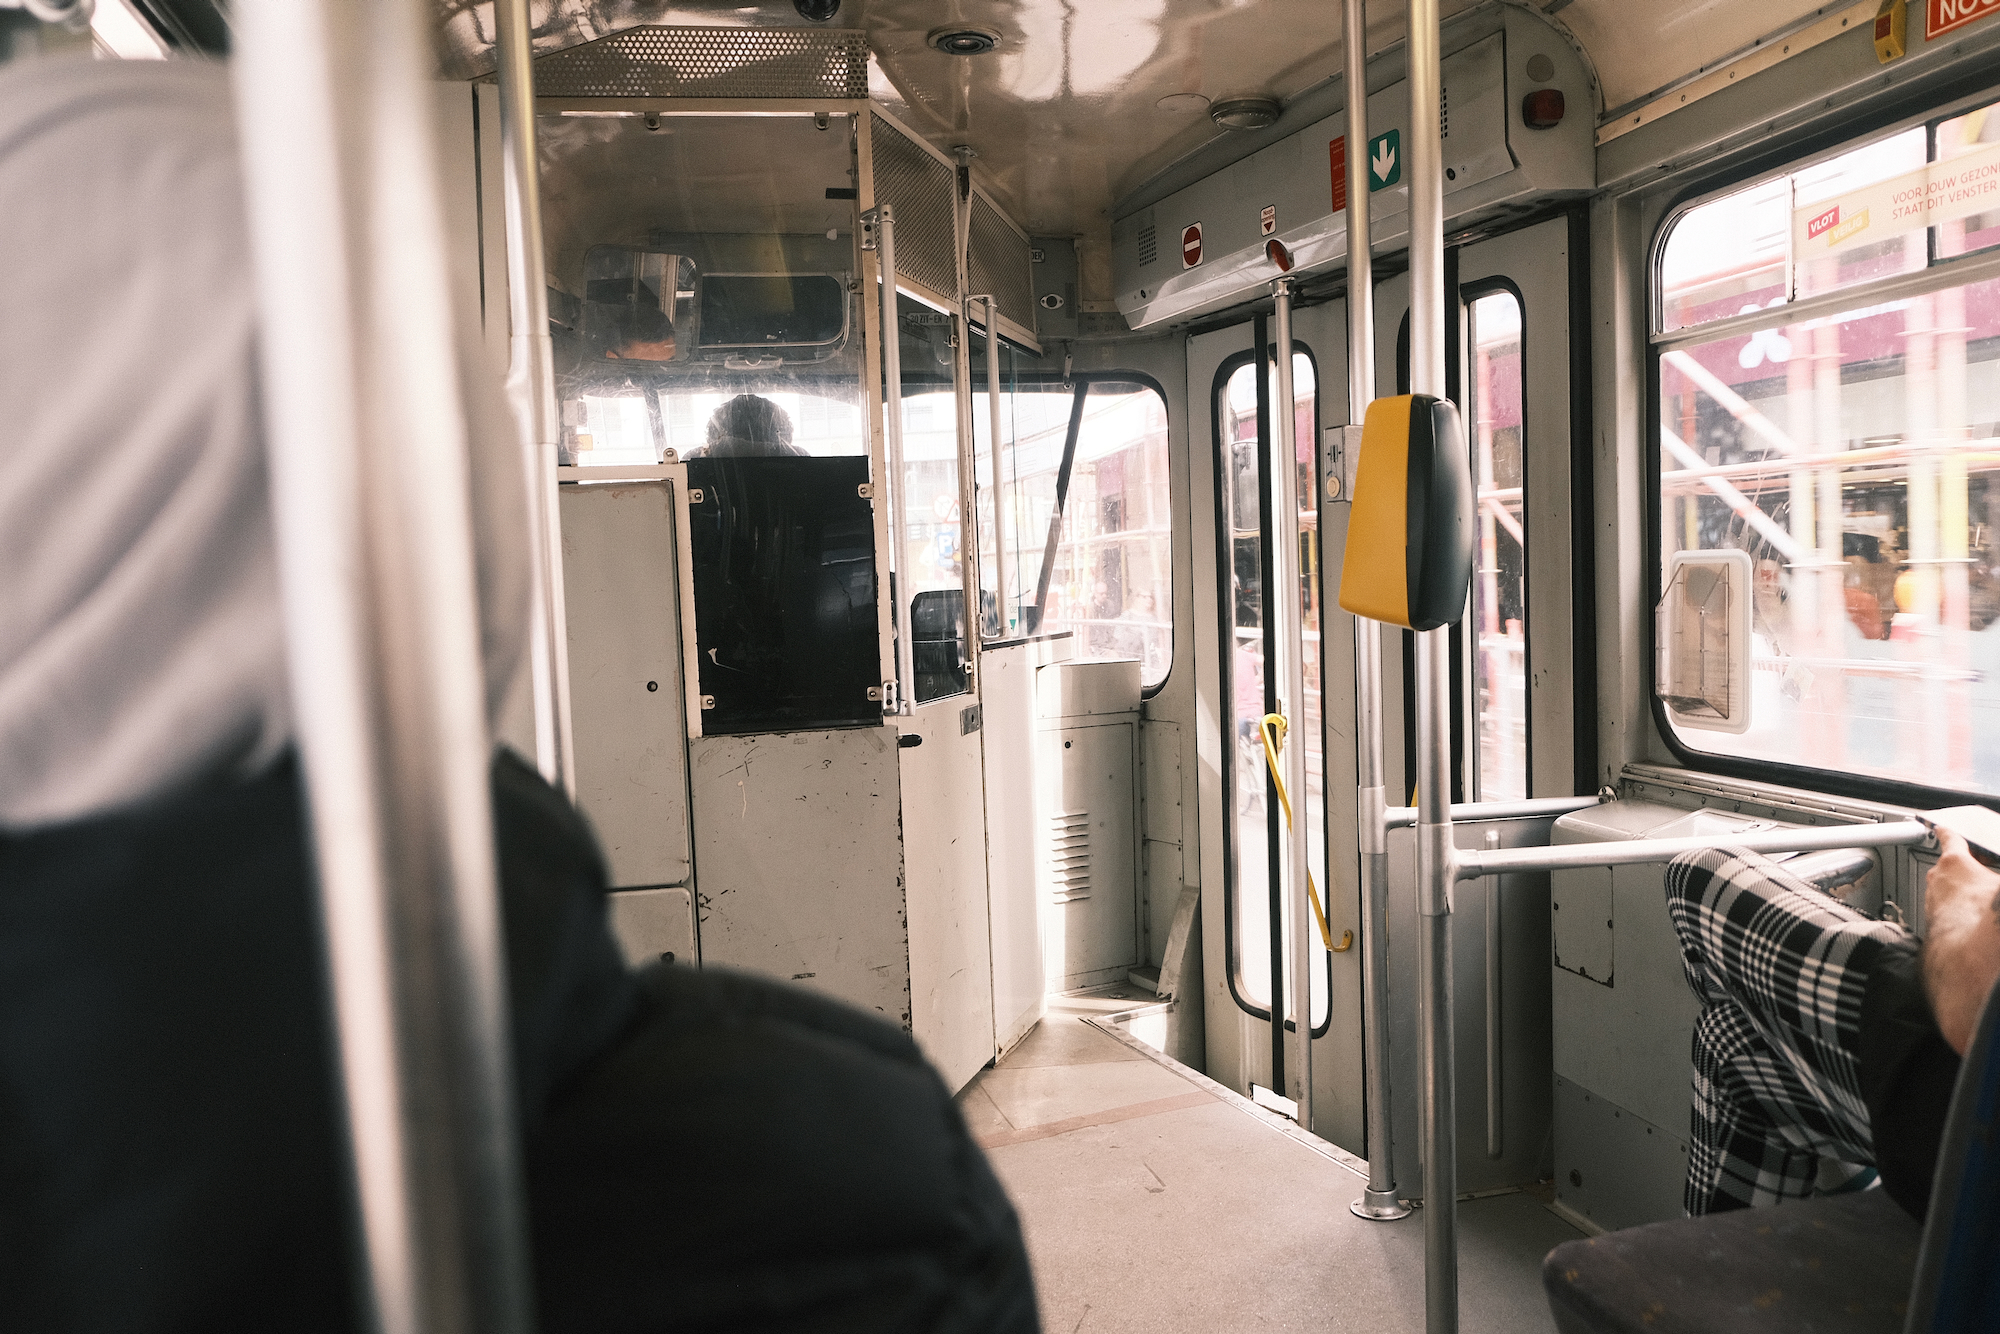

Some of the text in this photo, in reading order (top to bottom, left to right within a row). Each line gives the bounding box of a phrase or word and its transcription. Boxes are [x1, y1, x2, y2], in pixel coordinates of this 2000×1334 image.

[1892, 162, 2000, 204] VOOR JOUW GEZON
[1892, 180, 1997, 219] STAAT DIT VENSTER
[1811, 211, 1835, 233] VLOT
[1833, 215, 1863, 239] VEILIG
